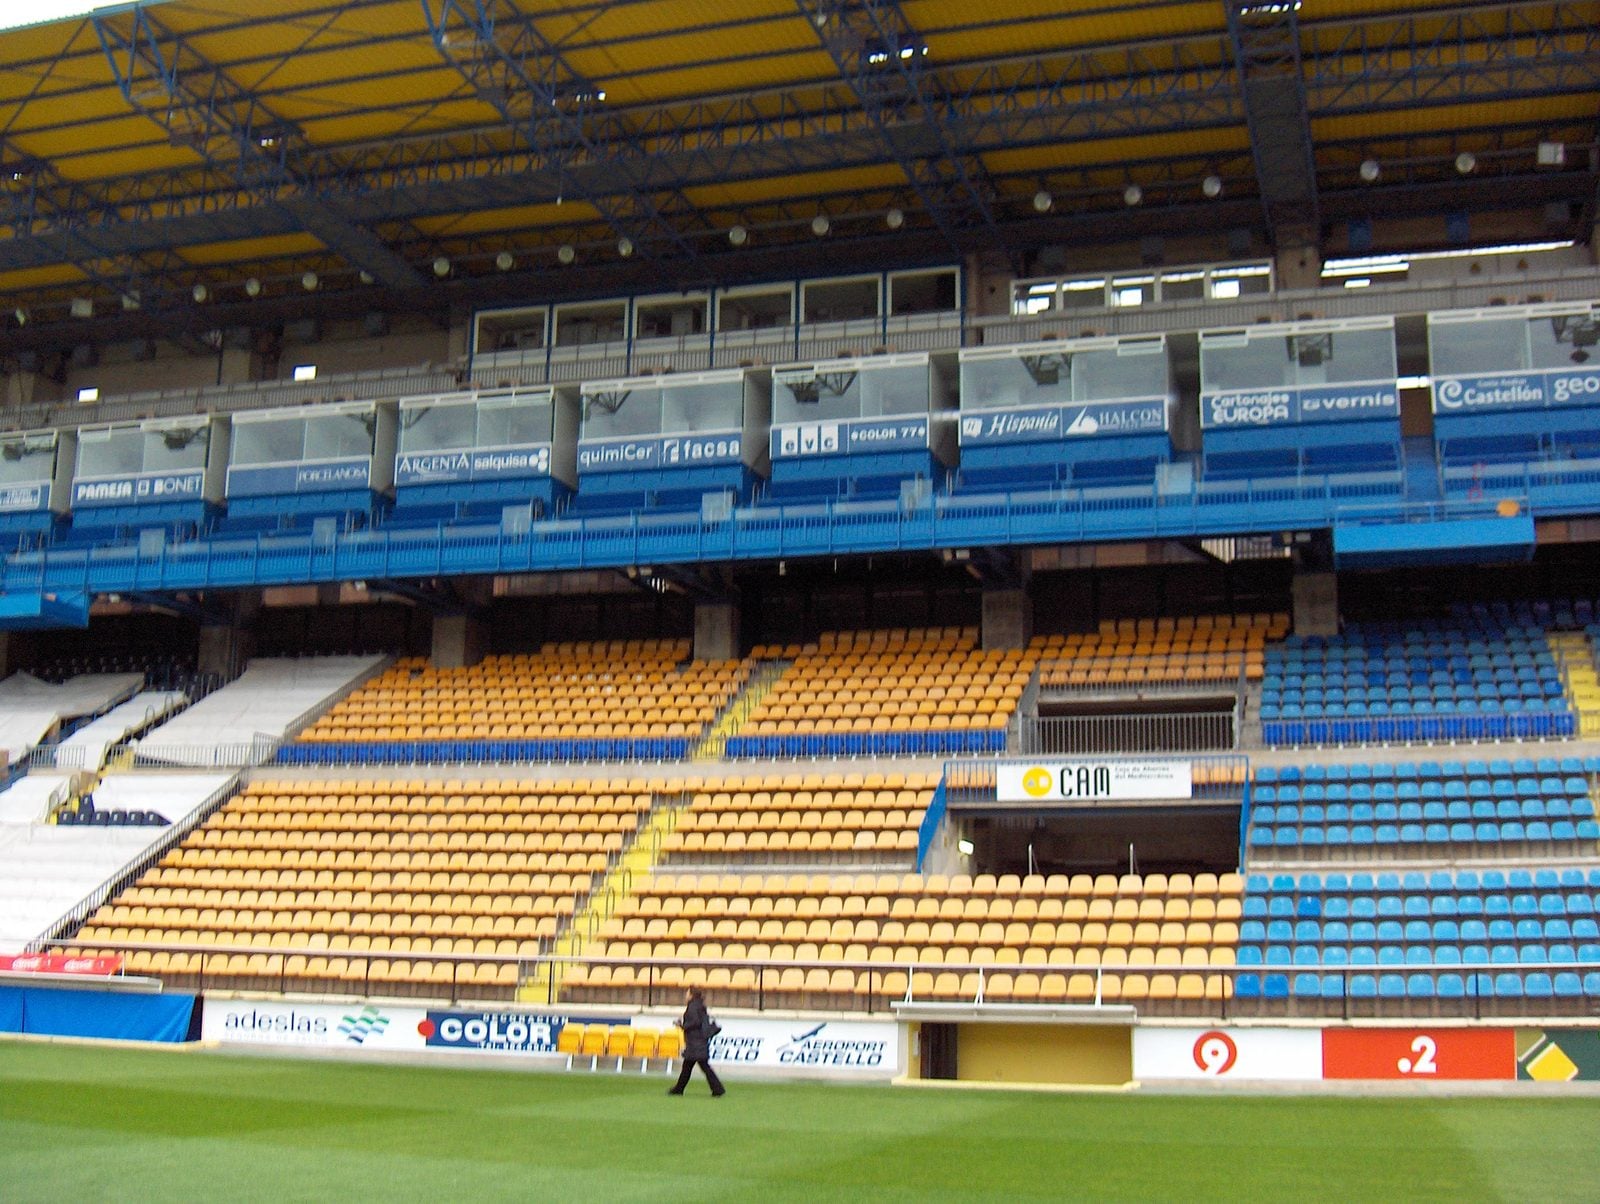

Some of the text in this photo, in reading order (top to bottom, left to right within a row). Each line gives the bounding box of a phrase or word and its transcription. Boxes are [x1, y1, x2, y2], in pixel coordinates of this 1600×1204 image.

[858, 426, 916, 441] COLOR 77
[985, 411, 1059, 437] Hispania
[683, 440, 740, 460] facsa
[398, 452, 470, 474] ARGENTA
[474, 453, 528, 471] salquisa
[77, 481, 132, 500] PAMESA
[153, 475, 201, 496] BONET
[1059, 767, 1110, 797] CAM
[225, 1008, 327, 1034] adeslas
[440, 1018, 551, 1046] COLOR
[707, 1036, 764, 1048] OPORT
[803, 1040, 888, 1051] AEROPORT
